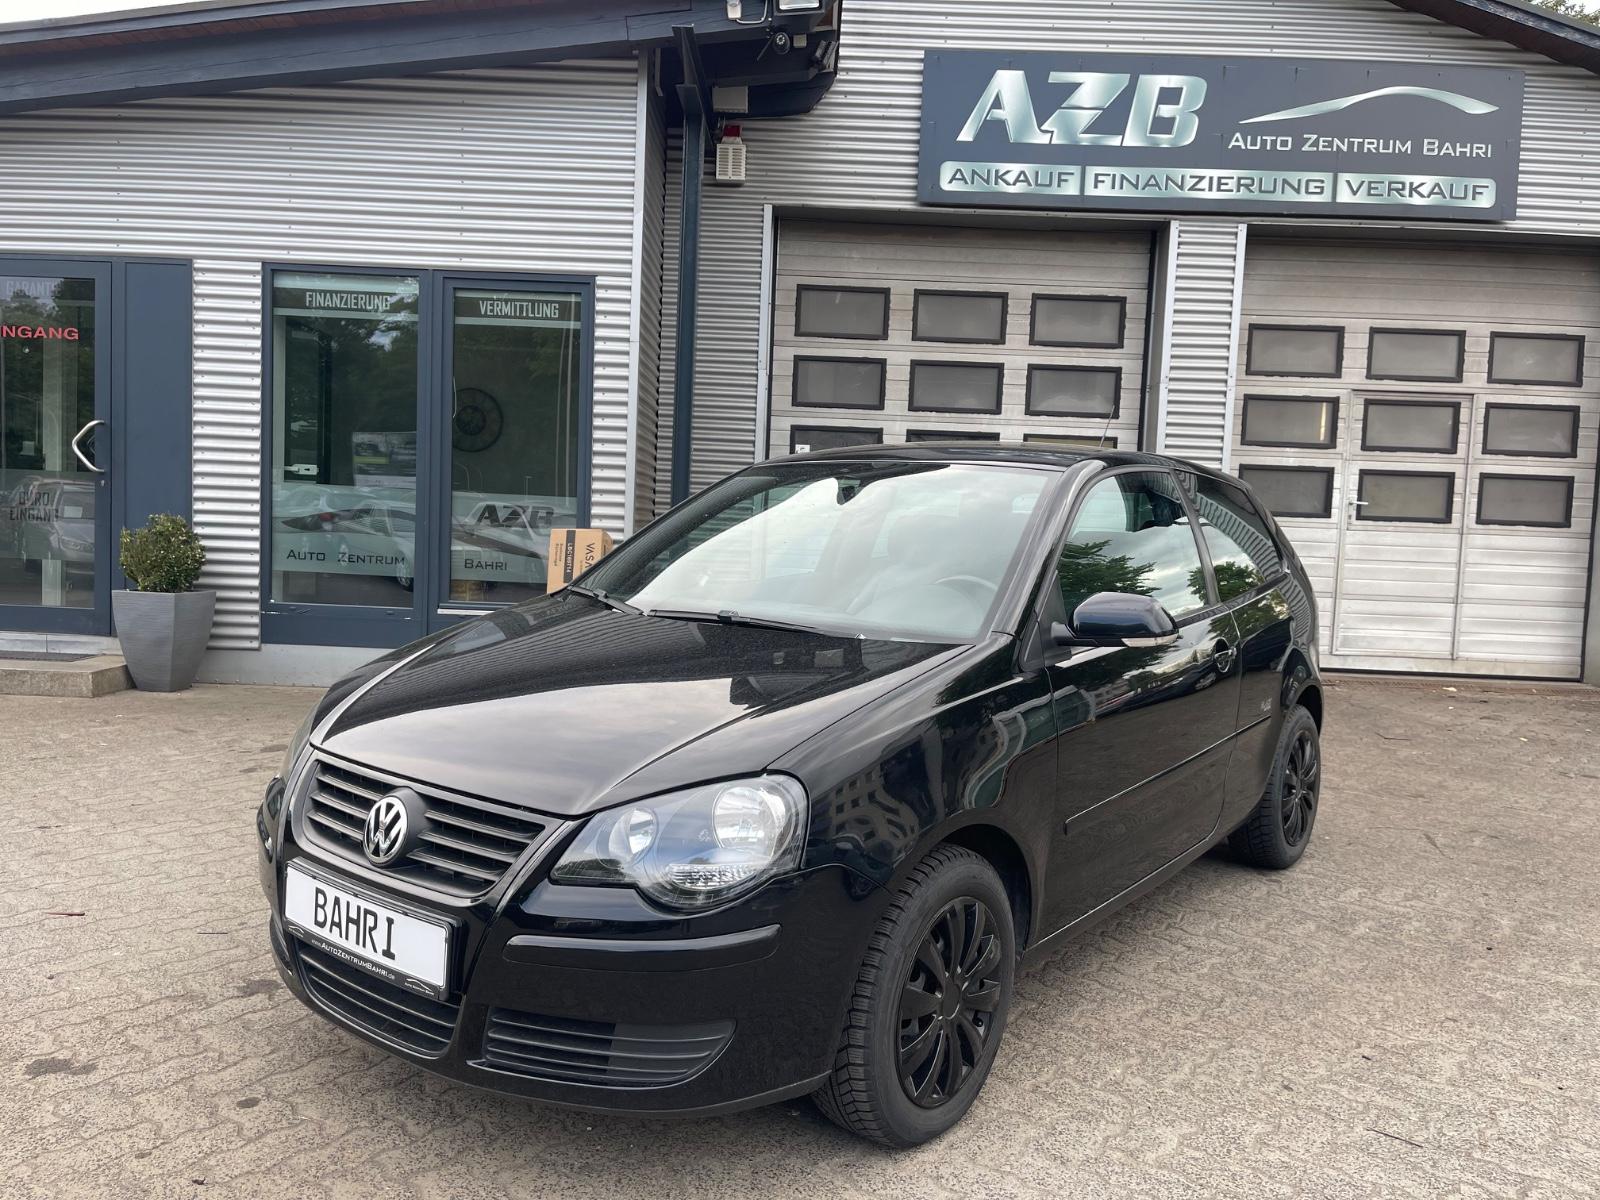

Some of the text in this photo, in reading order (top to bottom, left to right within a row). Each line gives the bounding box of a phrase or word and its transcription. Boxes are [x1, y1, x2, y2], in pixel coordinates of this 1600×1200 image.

[956, 69, 1208, 147] AZB
[1228, 132, 1492, 158] AUTO ZENTRUM BAHRI
[947, 168, 1076, 188] ANKAUF
[1093, 172, 1326, 195] FINANZIERUNG
[1345, 179, 1490, 201] VERKAUF
[305, 291, 391, 310] FINANZIERUNG
[479, 300, 559, 318] VERMITTLUNG
[286, 549, 508, 571] AUTO ZENTRUM BAHRI
[314, 886, 396, 961] BAHRI
